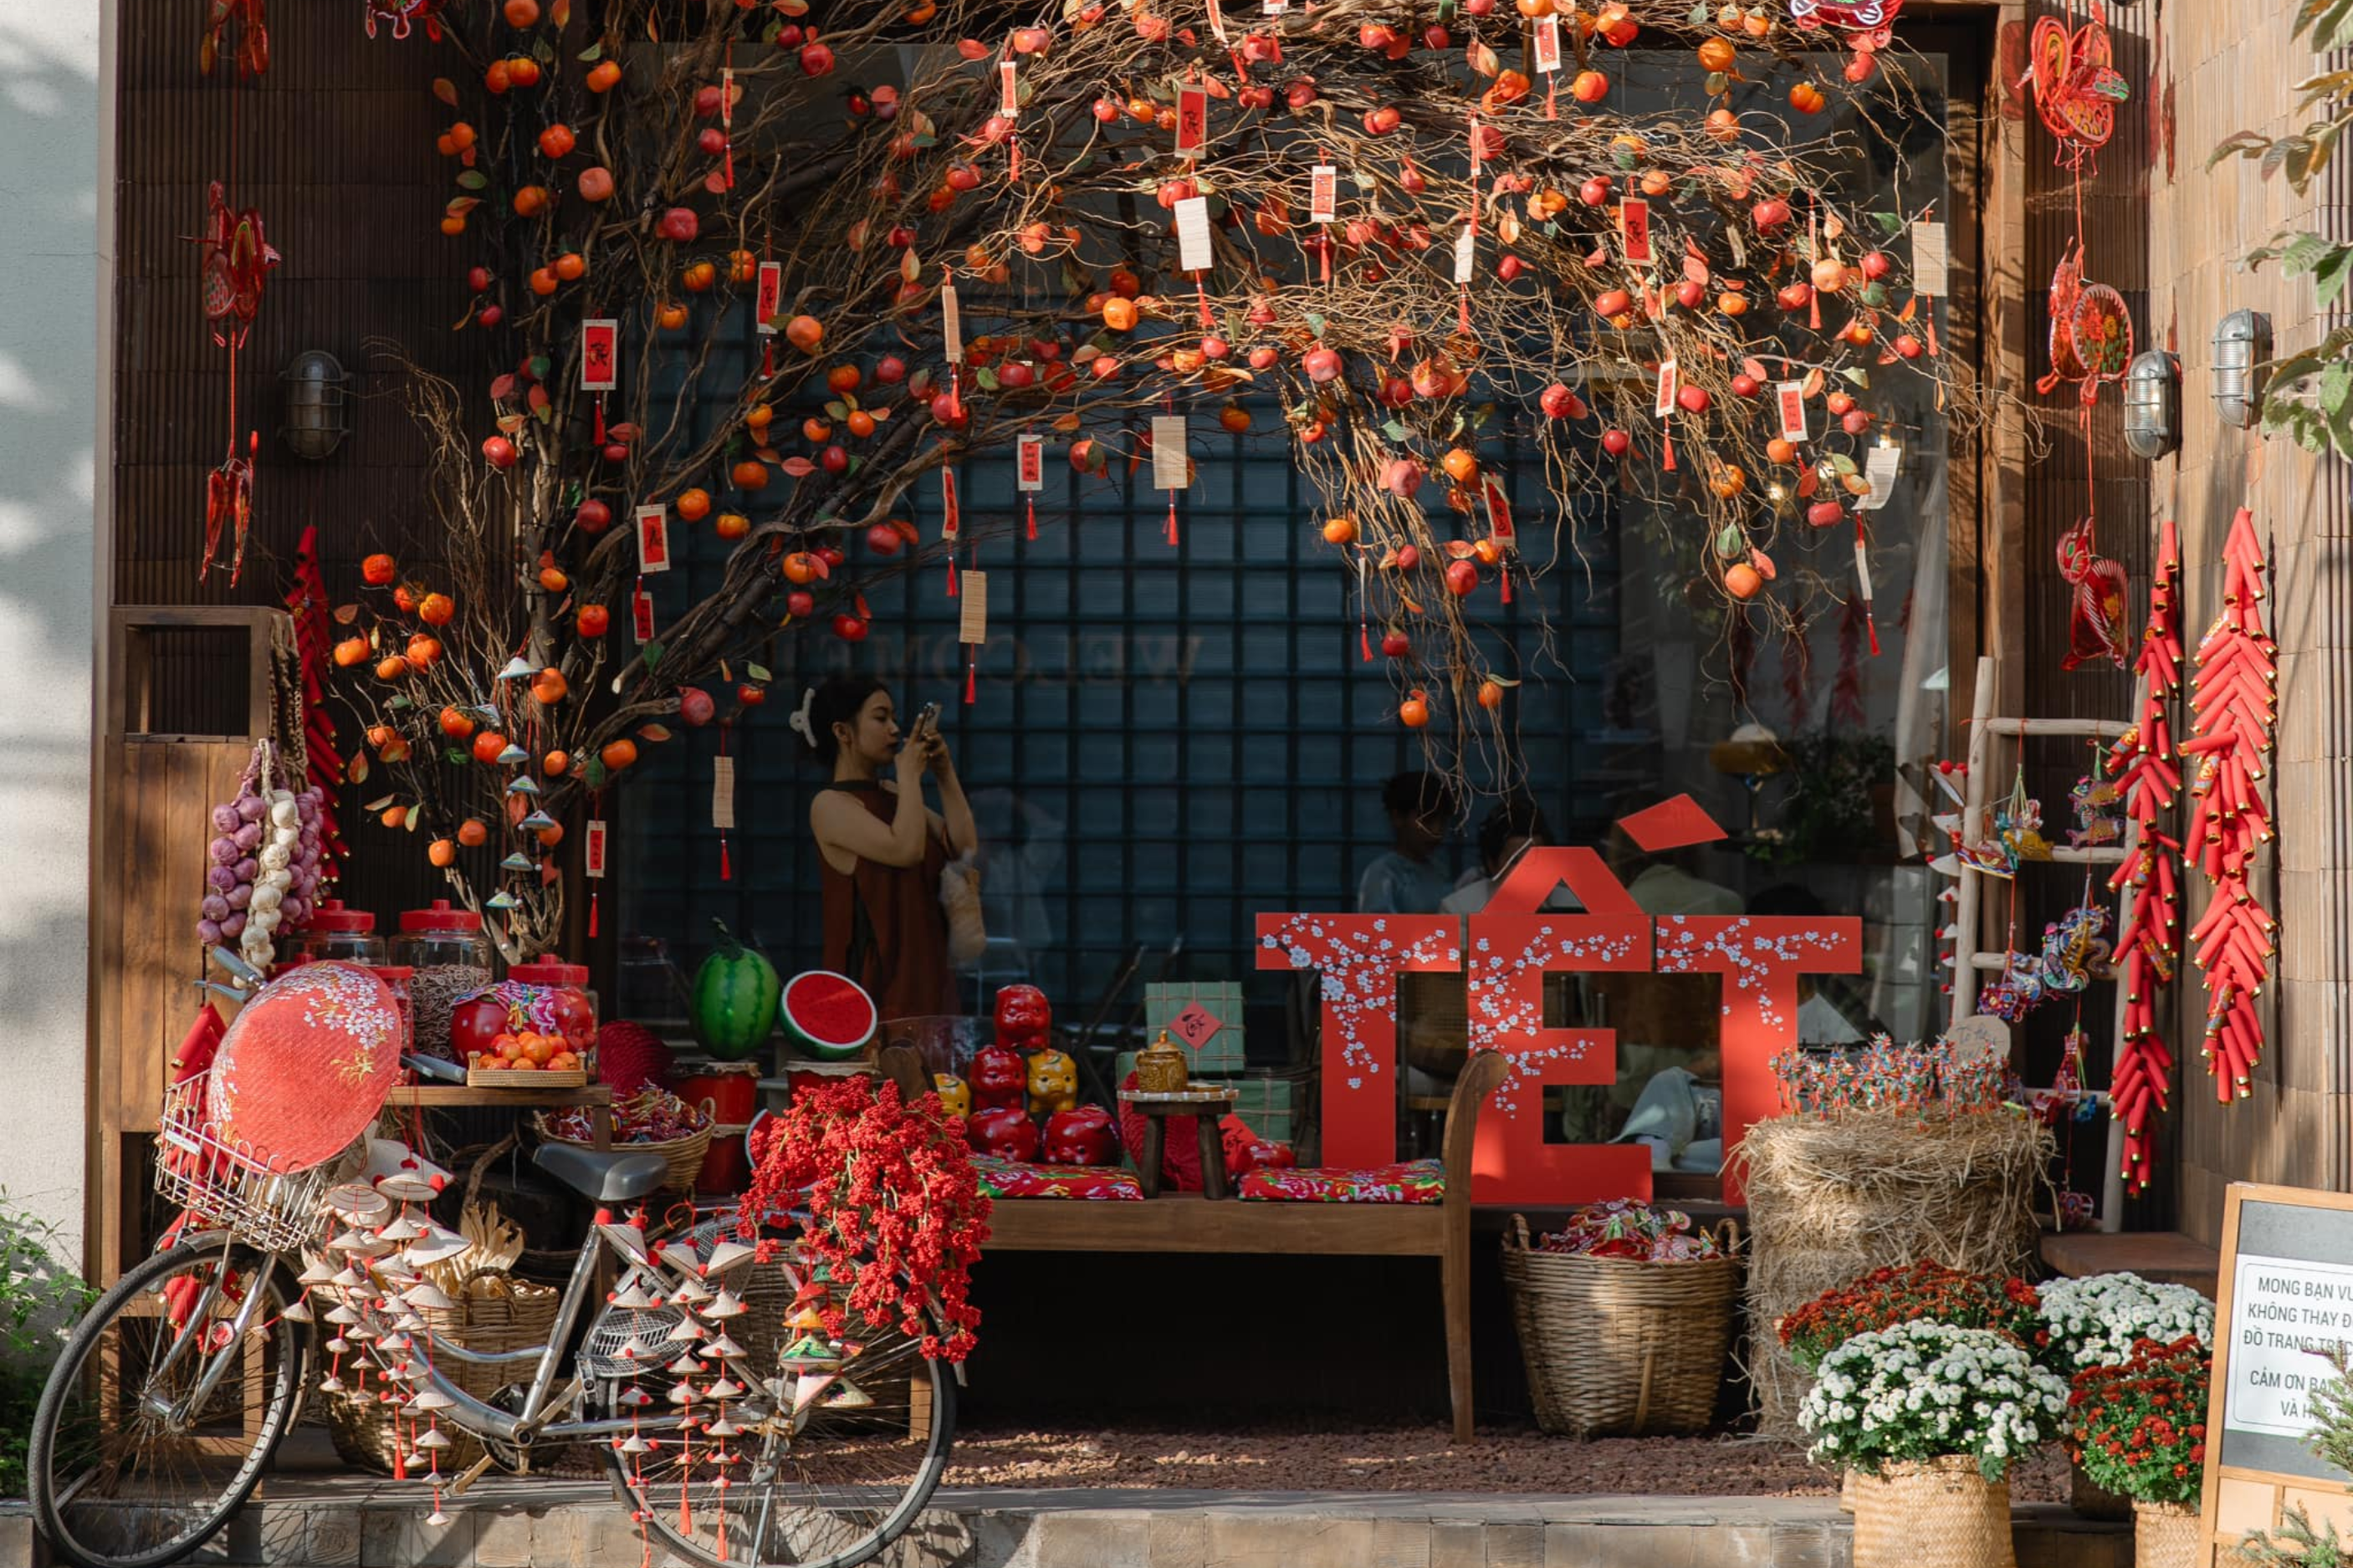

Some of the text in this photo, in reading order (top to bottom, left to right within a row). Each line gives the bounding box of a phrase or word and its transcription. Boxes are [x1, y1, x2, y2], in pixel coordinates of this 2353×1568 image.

[1256, 793, 1862, 1207] TẾT
[2258, 1277, 2300, 1295] MONG
[2304, 1282, 2334, 1301] BẠN
[2248, 1301, 2298, 1322] KHÔNG
[2302, 1309, 2339, 1326] THAY
[2244, 1325, 2263, 1346] ĐỒ
[2267, 1333, 2315, 1351] TRANG
[2250, 1366, 2280, 1388] CẢM
[2285, 1374, 2305, 1391] ƠN
[2281, 1398, 2299, 1417] VÀ
